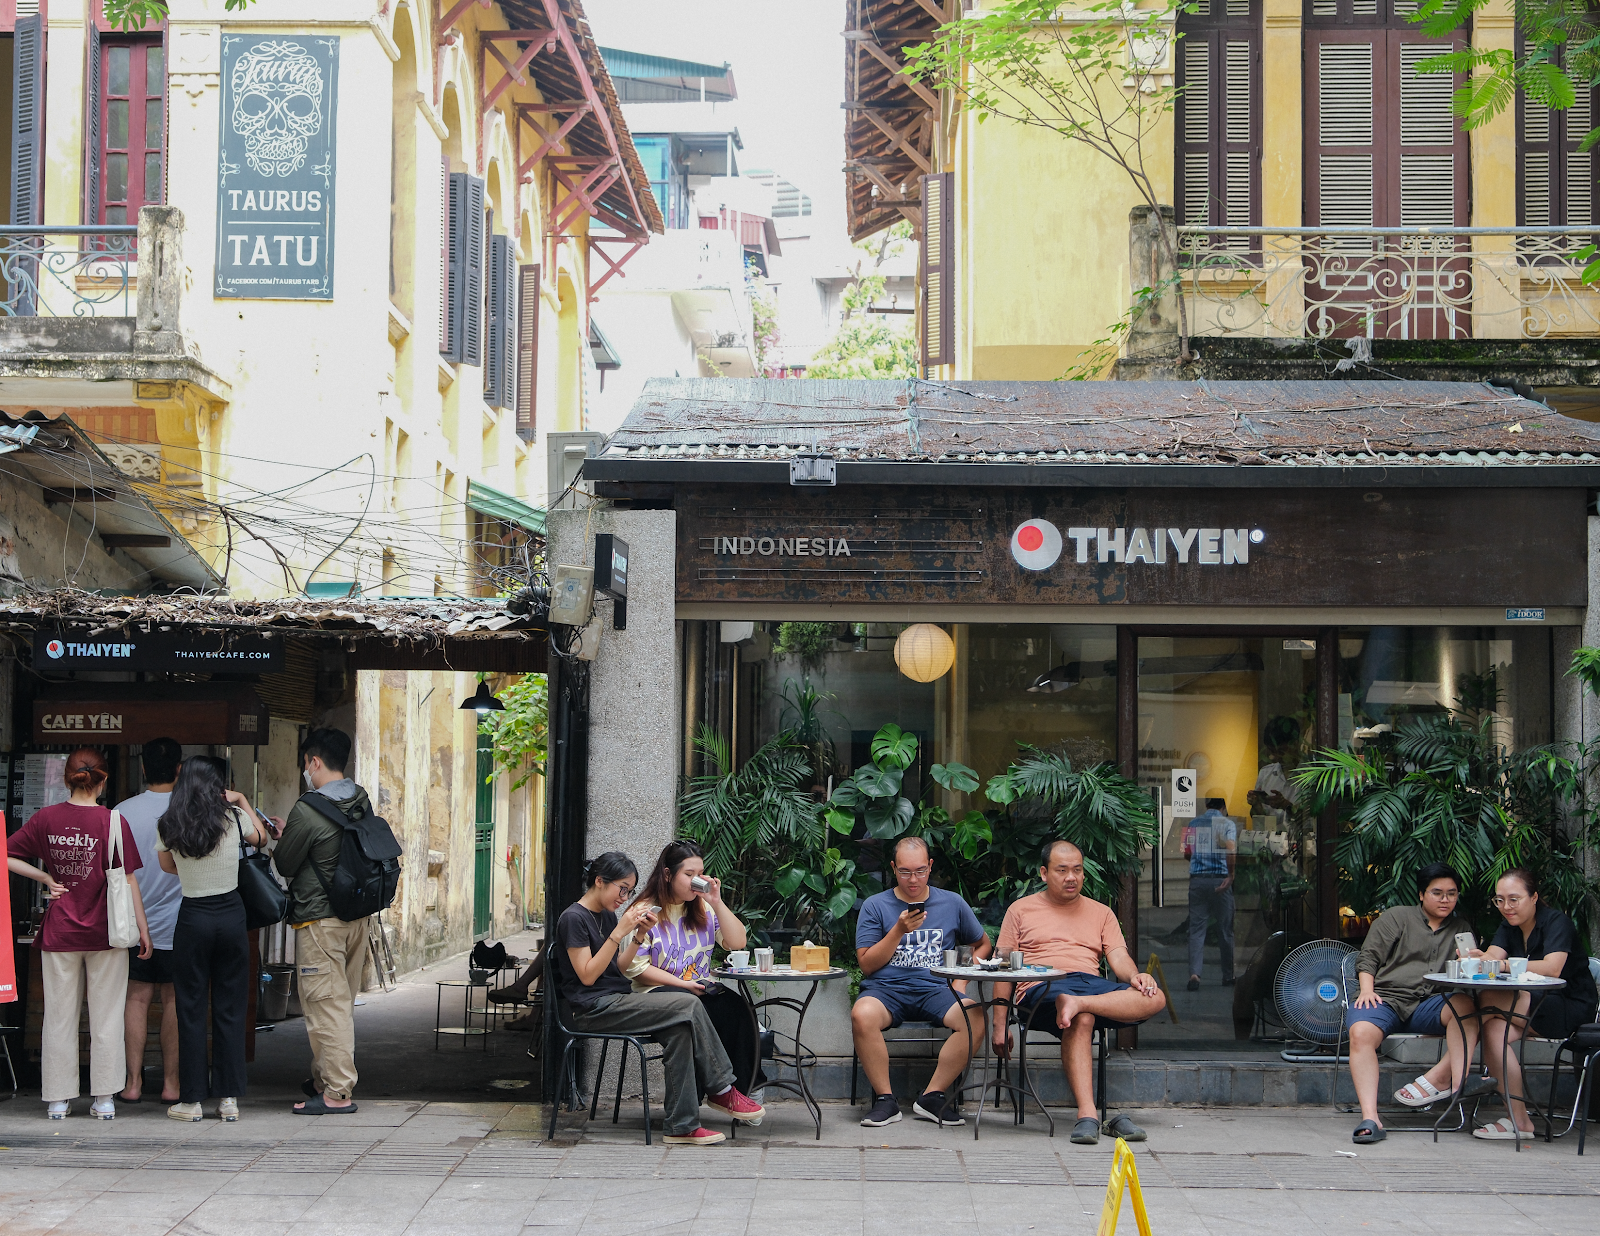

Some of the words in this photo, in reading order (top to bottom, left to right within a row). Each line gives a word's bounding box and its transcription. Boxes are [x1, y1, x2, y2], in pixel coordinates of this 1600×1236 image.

[228, 190, 321, 212] TAURUS
[228, 235, 320, 267] TATU
[713, 536, 852, 557] INDONESIA
[174, 650, 270, 659] THAIYENCAFE.COM
[41, 714, 85, 729] CAFE
[1173, 800, 1194, 808] PUSH
[47, 833, 99, 851] weekly
[54, 861, 94, 881] eekly
